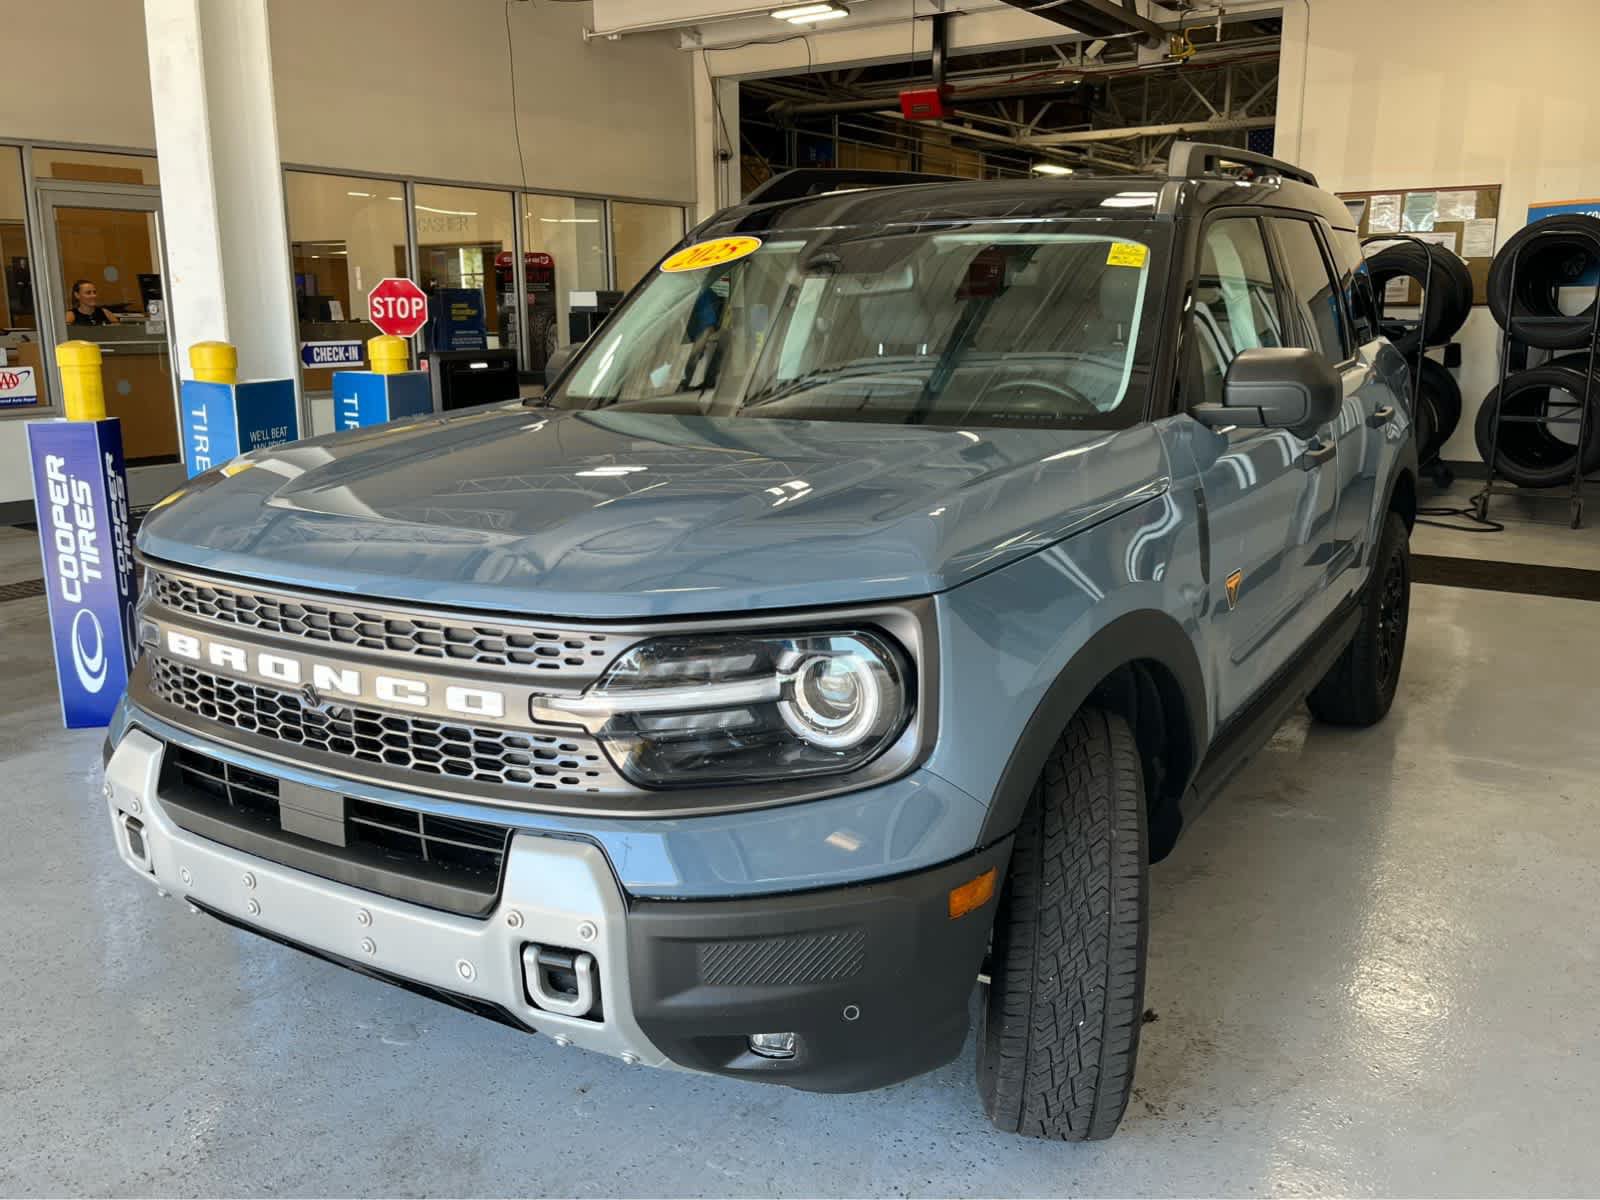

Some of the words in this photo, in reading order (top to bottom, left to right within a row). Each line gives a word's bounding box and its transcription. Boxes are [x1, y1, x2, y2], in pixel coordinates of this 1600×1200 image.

[372, 297, 423, 319] STOP
[313, 346, 359, 362] CHECK-IN
[191, 403, 212, 472] TIRE
[249, 429, 270, 443] WE'LL
[271, 425, 288, 439] BEAT
[45, 454, 82, 604] COOPER
[71, 478, 102, 584] TIRES
[105, 452, 129, 596] COOPER
[167, 630, 505, 718] BRONCO
